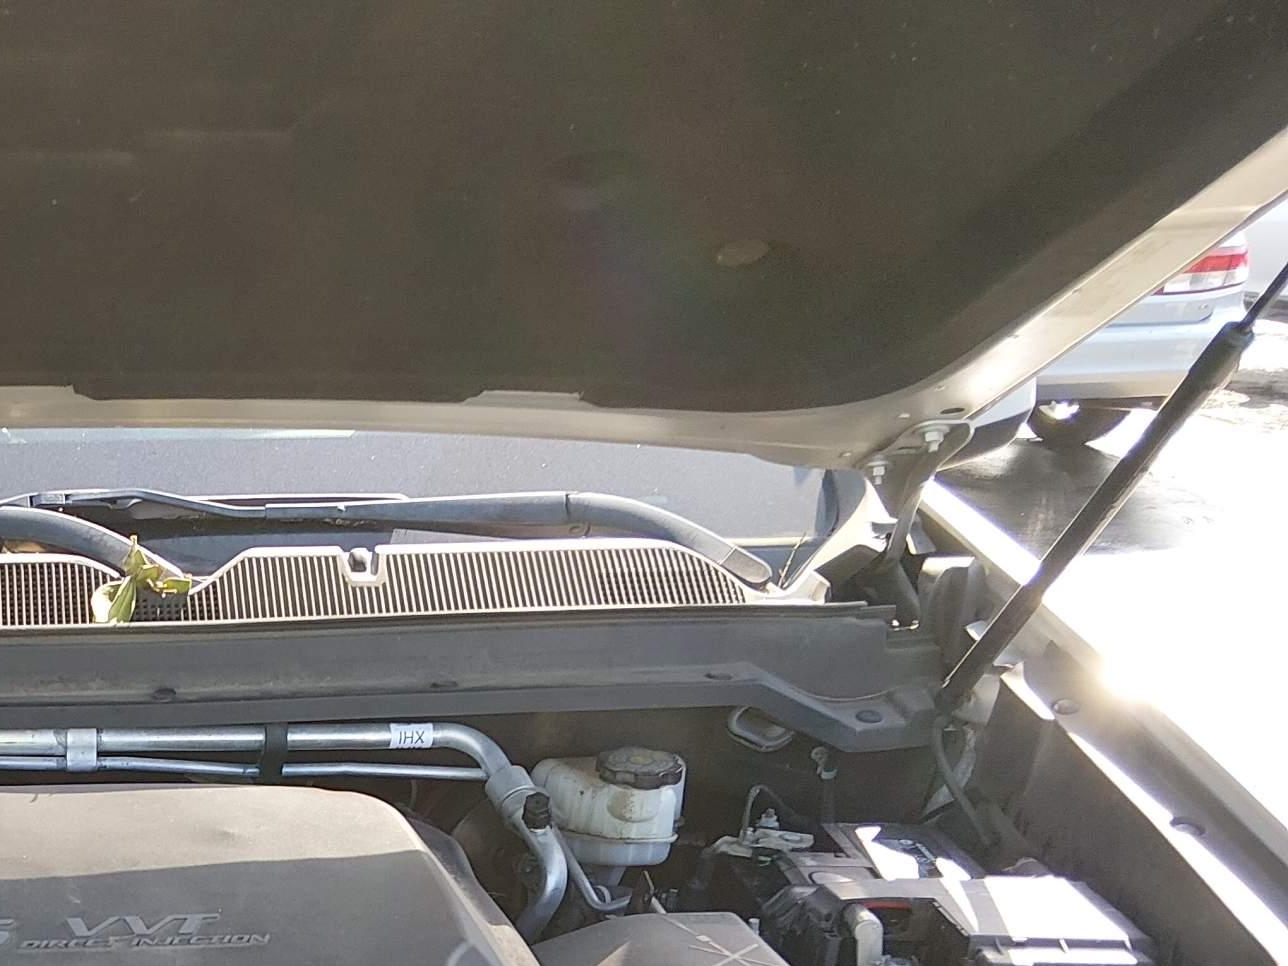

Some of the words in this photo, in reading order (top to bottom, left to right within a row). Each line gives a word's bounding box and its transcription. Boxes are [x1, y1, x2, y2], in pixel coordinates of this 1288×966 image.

[398, 730, 425, 745] IHX
[66, 912, 220, 937] VVT
[130, 933, 271, 948] INJECTION
